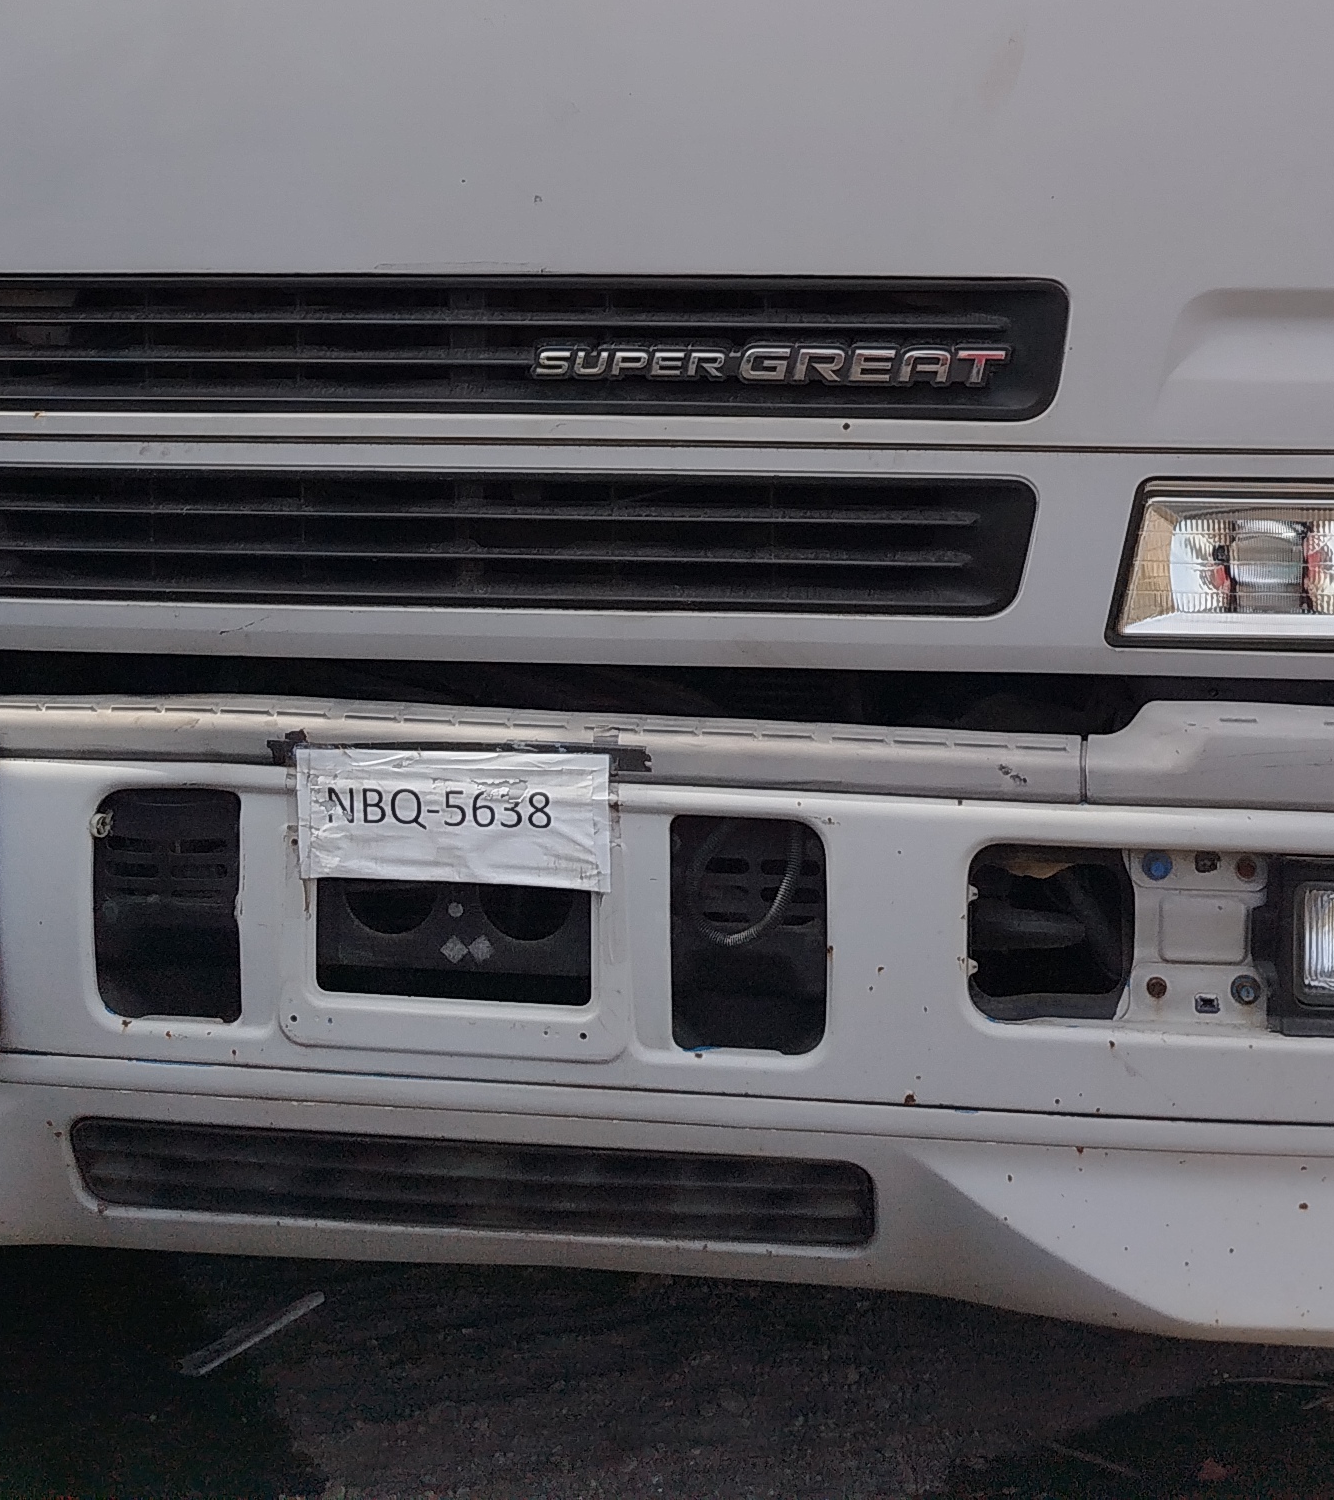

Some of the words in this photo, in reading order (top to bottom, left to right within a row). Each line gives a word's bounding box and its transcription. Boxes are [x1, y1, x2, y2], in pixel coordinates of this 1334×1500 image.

[535, 348, 727, 380] SUPER
[739, 346, 1008, 384] GREAT
[326, 786, 554, 830] NBQ-5638
